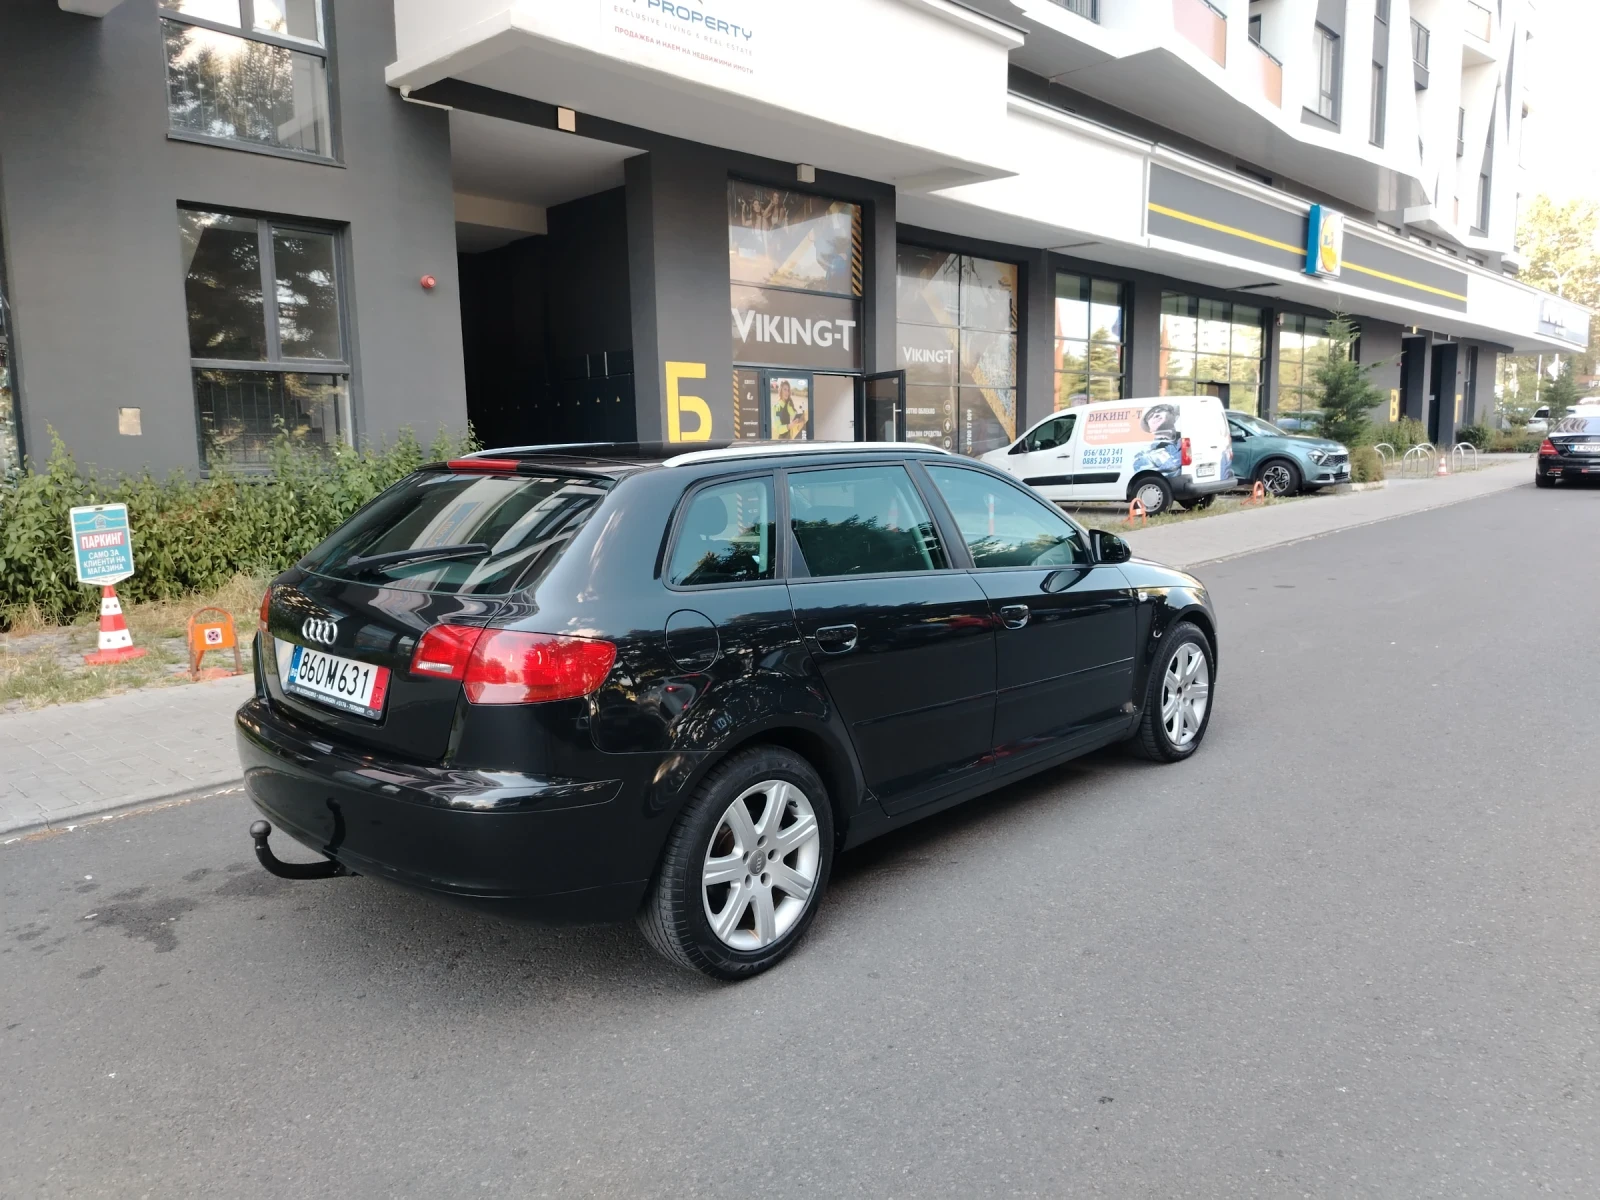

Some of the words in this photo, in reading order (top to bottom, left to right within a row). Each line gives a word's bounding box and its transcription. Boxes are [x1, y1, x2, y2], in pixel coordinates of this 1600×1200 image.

[648, 0, 752, 41] PROPERTY
[613, 5, 660, 26] EXCLUSIVE
[664, 22, 692, 36] LIVING
[703, 35, 722, 47] REAL
[726, 43, 752, 56] ESTATE
[614, 26, 655, 44] ПРОДАЖБА
[662, 41, 681, 53] НАЕМ
[692, 51, 732, 68] НЕДВИЖИМИ
[733, 64, 754, 75] ИМОТИ
[665, 361, 713, 444] Б
[1088, 411, 1130, 422] ВИКИНГ
[82, 532, 122, 549] ПАРКИНГ
[83, 557, 115, 568] КЛИЕНТИ
[117, 555, 126, 563] НА
[89, 550, 108, 560] САМО
[110, 549, 119, 557] ЗА
[87, 563, 124, 575] МАГАЗИНА
